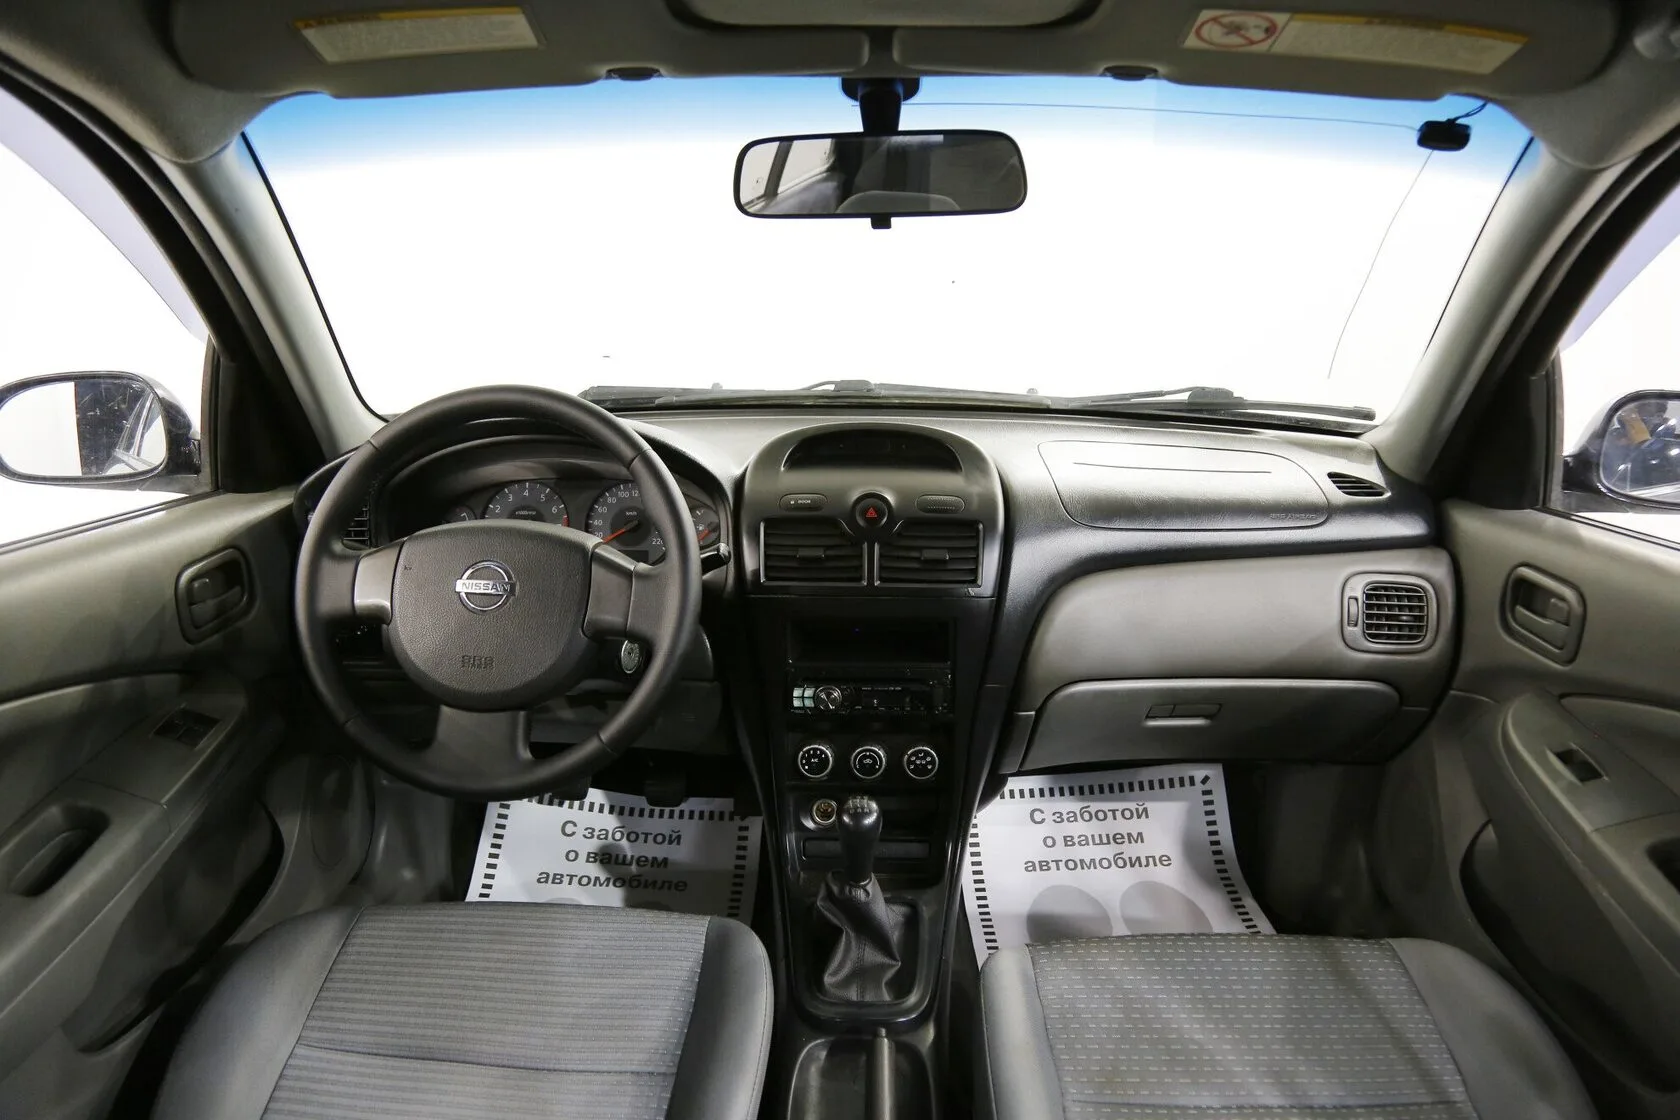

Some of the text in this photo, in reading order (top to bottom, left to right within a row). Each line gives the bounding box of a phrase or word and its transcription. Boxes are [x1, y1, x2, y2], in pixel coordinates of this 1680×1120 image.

[495, 505, 501, 513] 2
[461, 582, 511, 592] NISSAN
[1029, 803, 1150, 824] С заботой
[560, 820, 682, 846] С заботой
[1042, 831, 1144, 848] о вашем
[565, 849, 669, 869] о вашем
[1024, 851, 1172, 872] автомобиле
[536, 871, 688, 892] автомобиле
